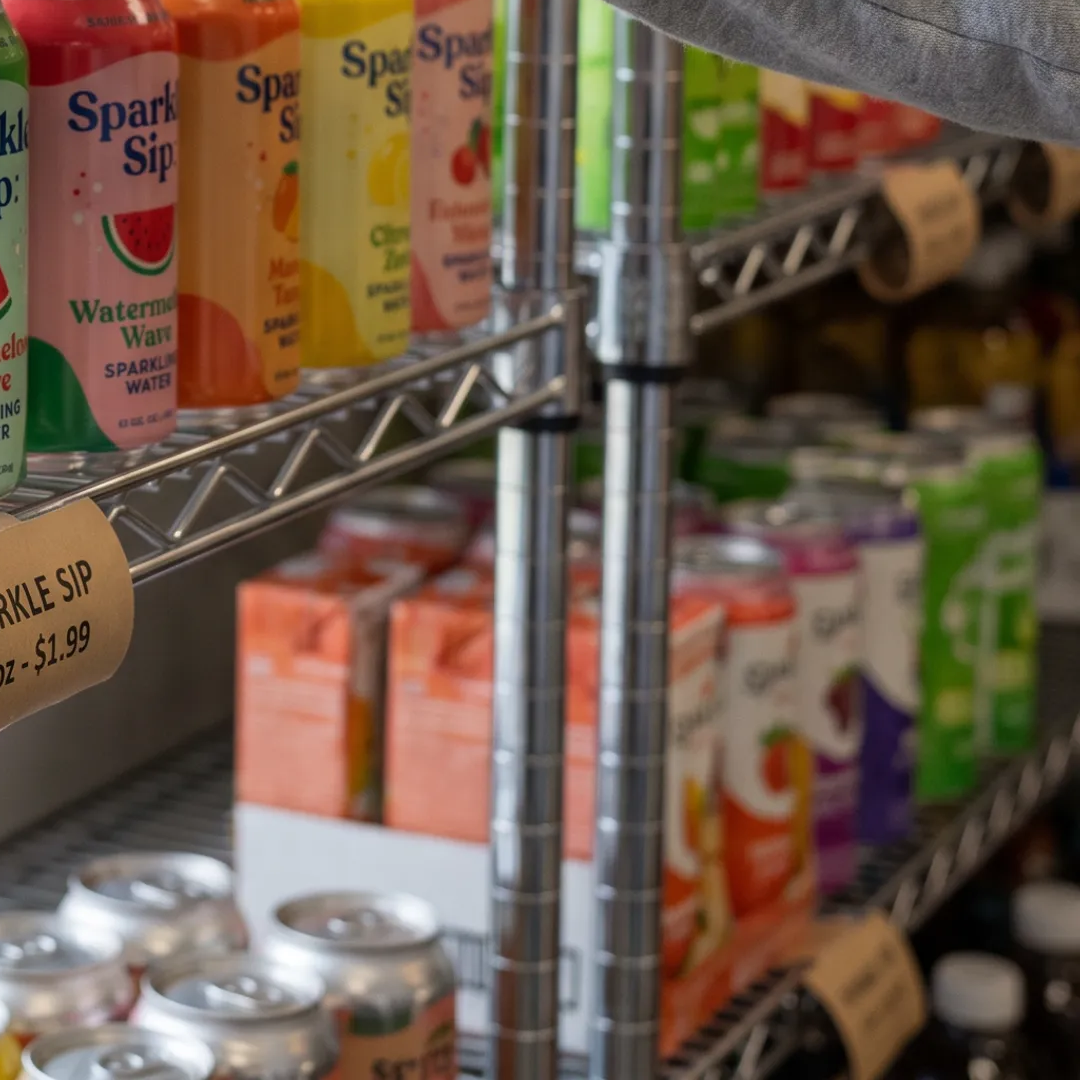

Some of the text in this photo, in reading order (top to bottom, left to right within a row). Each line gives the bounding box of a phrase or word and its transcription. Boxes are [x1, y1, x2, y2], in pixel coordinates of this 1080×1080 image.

[67, 81, 178, 142] Spark
[56, 559, 93, 602] SIP
[35, 620, 90, 676] $1.99
